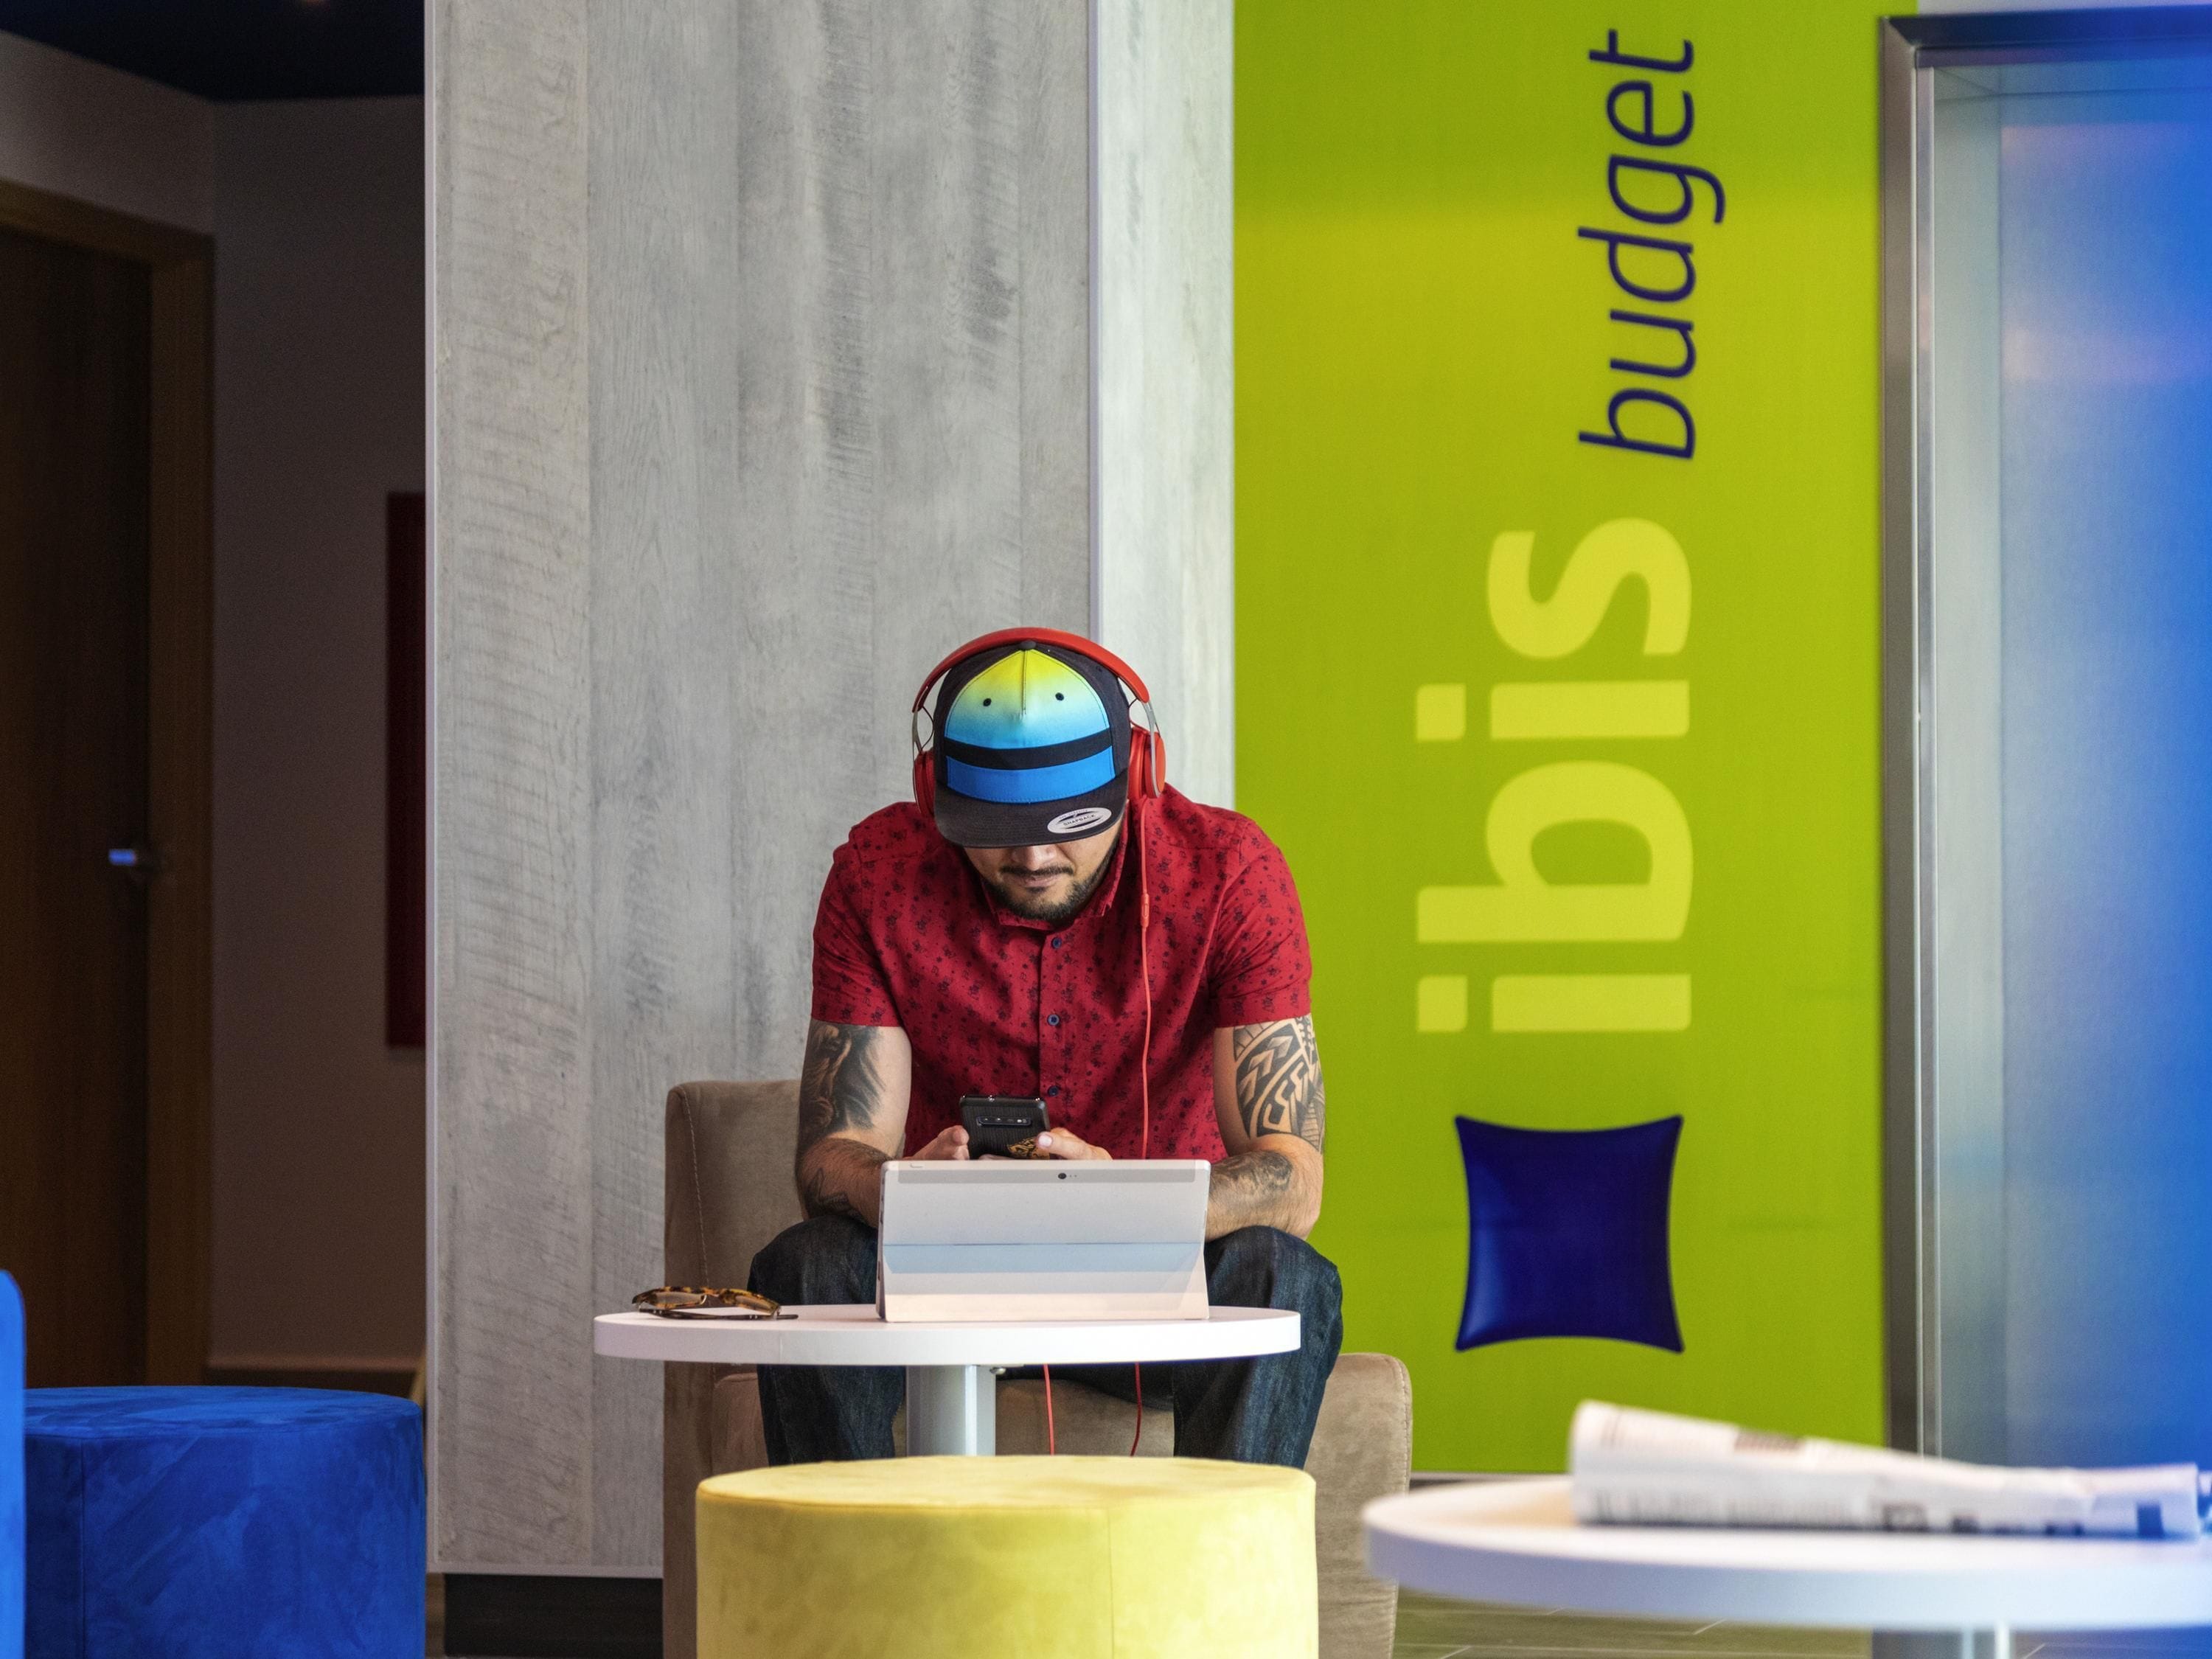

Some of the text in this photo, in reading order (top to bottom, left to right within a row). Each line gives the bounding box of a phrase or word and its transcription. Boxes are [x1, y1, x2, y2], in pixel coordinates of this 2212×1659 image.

[1416, 28, 1726, 1032] ibis budget
[1062, 814, 1096, 826] SNAPBACK
